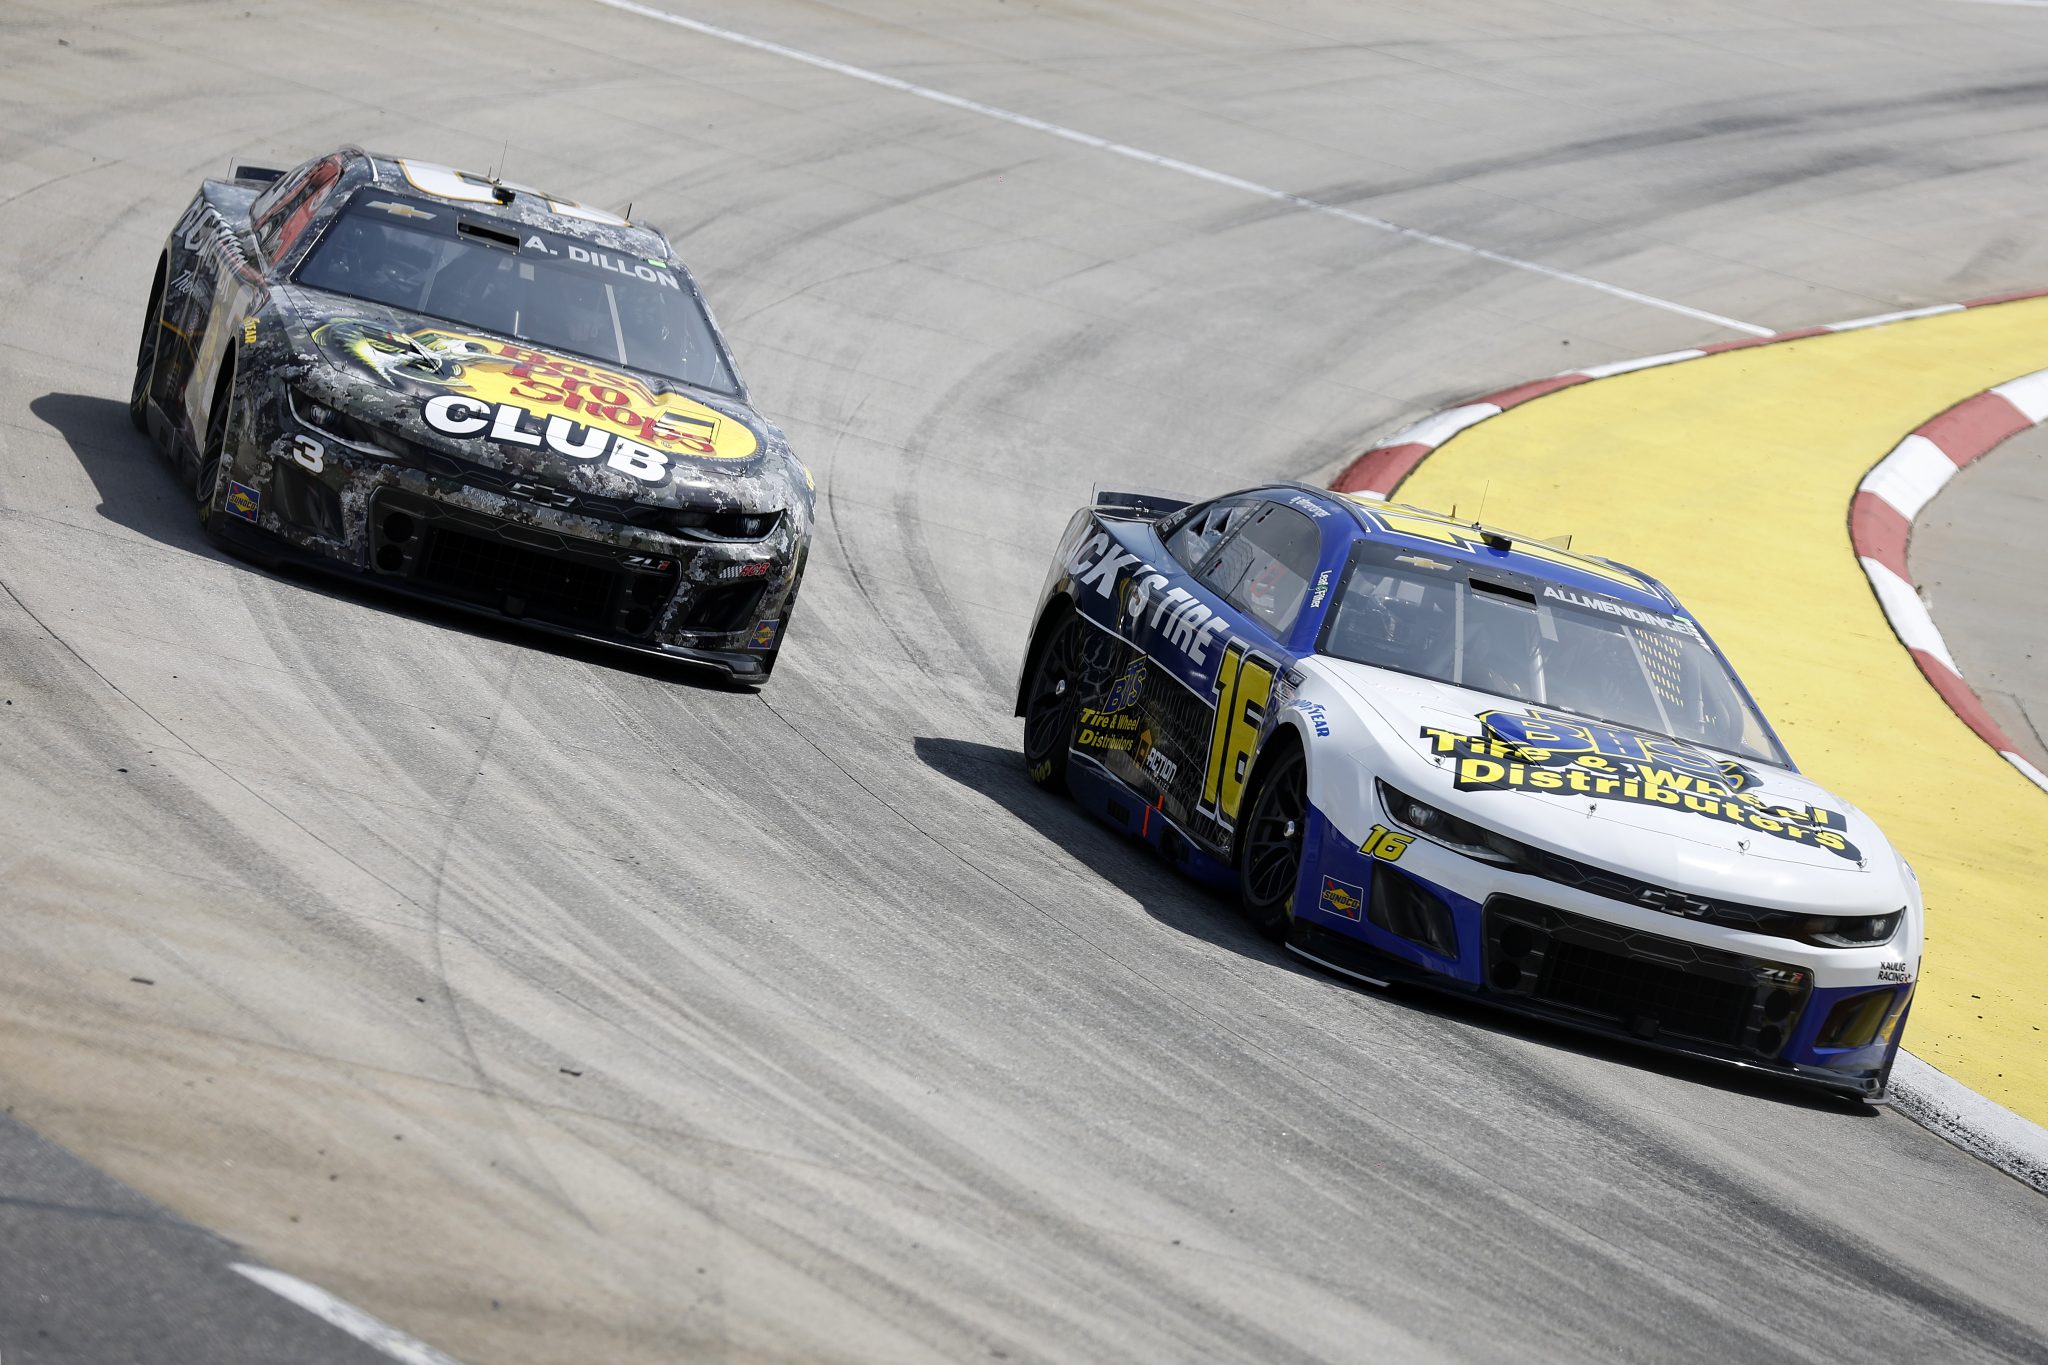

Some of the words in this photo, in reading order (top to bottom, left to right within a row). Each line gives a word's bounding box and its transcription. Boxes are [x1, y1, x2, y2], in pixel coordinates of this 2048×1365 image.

[525, 235, 558, 255] A.
[568, 245, 680, 290] DILLON
[504, 361, 632, 408] Pro
[293, 434, 325, 474] 3
[424, 394, 670, 483] CLUB
[229, 494, 258, 511] SUNOCO
[626, 555, 671, 571] ZL1
[1150, 586, 1231, 667] TIRE
[1079, 707, 1109, 728] Tire
[1109, 714, 1118, 728] &
[1118, 714, 1141, 731] Wheel
[1202, 645, 1276, 824] 16
[1077, 728, 1134, 751] Distributors
[1146, 747, 1178, 784] ACTION
[1426, 727, 1552, 762] Tire
[1574, 755, 1618, 773] &
[1637, 764, 1830, 825] Wheel
[1459, 758, 1847, 851] Distributors
[1359, 823, 1418, 863] 16
[1322, 889, 1361, 910] SUNOCO
[1760, 967, 1804, 984] ZL1
[1877, 970, 1905, 982] RACING
